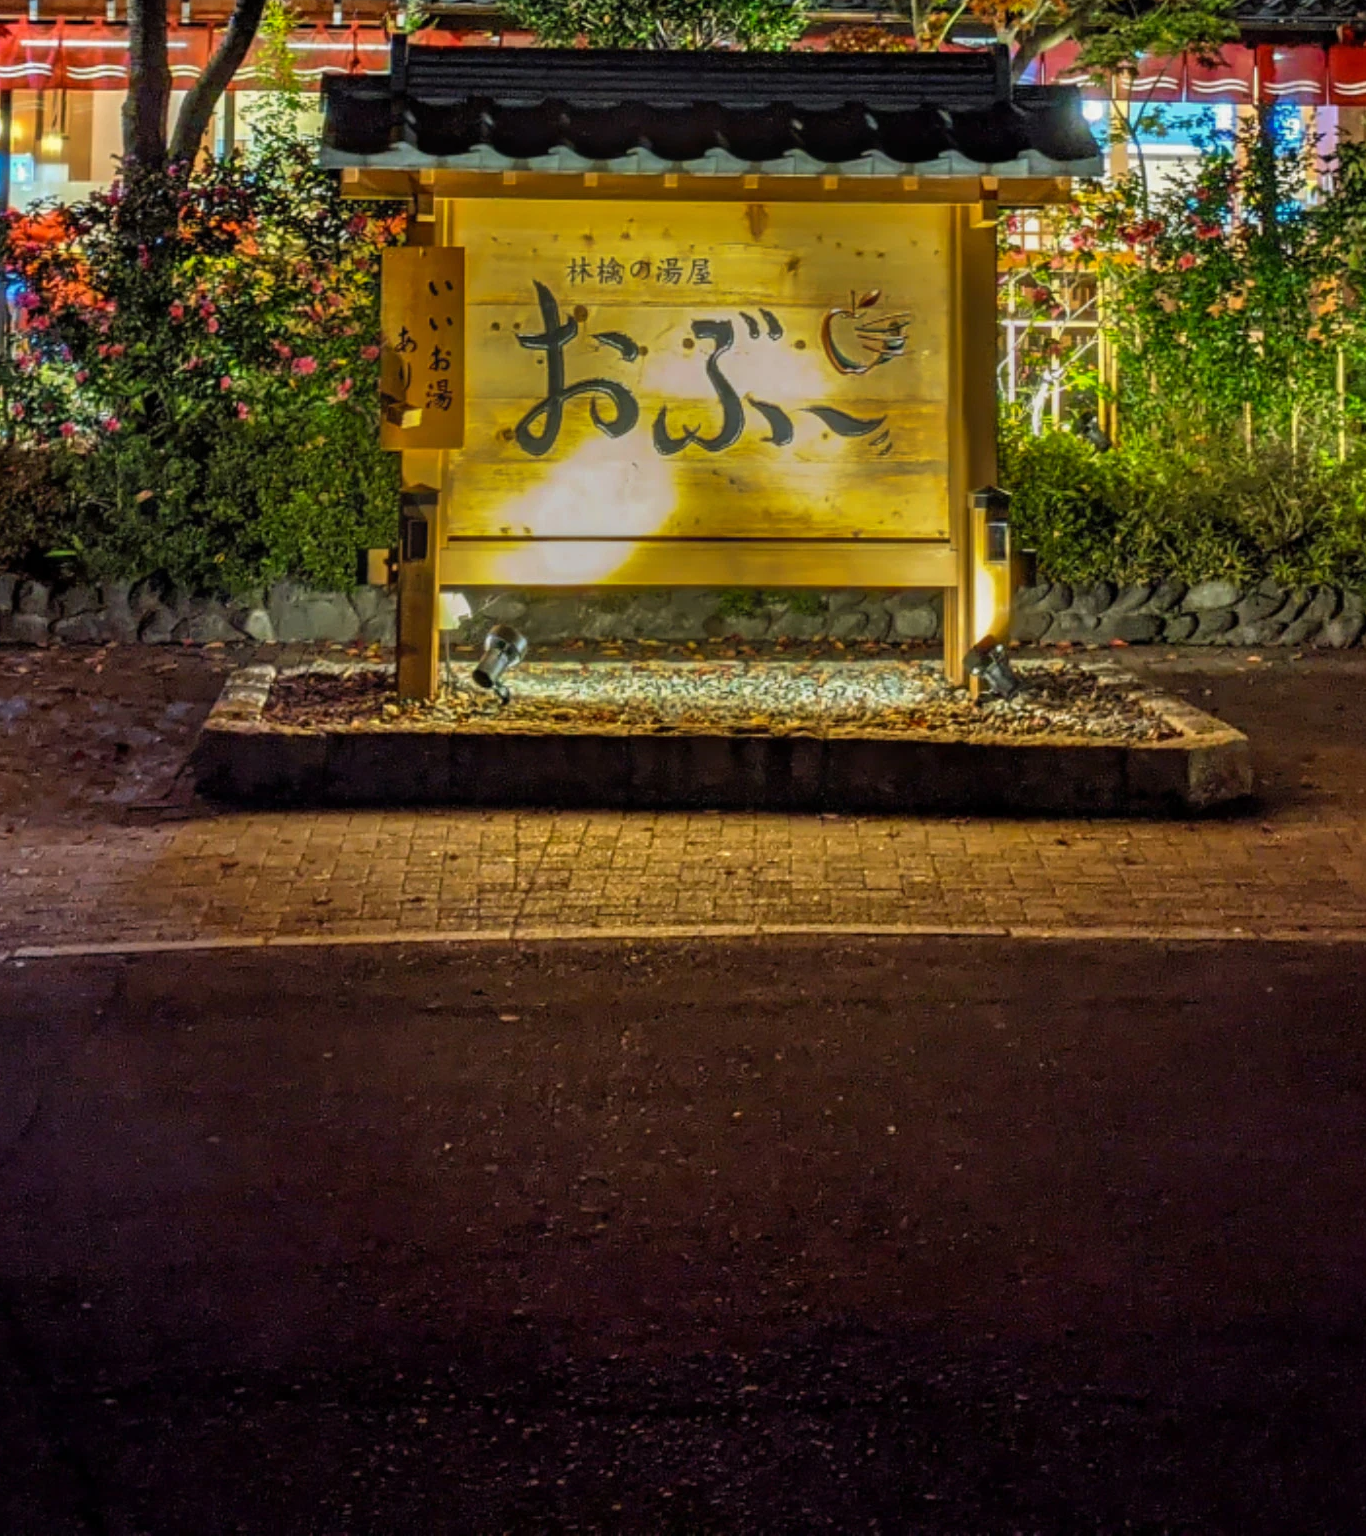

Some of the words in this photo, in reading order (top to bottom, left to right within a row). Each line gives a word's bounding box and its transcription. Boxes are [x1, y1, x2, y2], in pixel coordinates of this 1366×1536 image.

[566, 256, 713, 286] 林檎の湯屋
[426, 280, 453, 411] いいお湯
